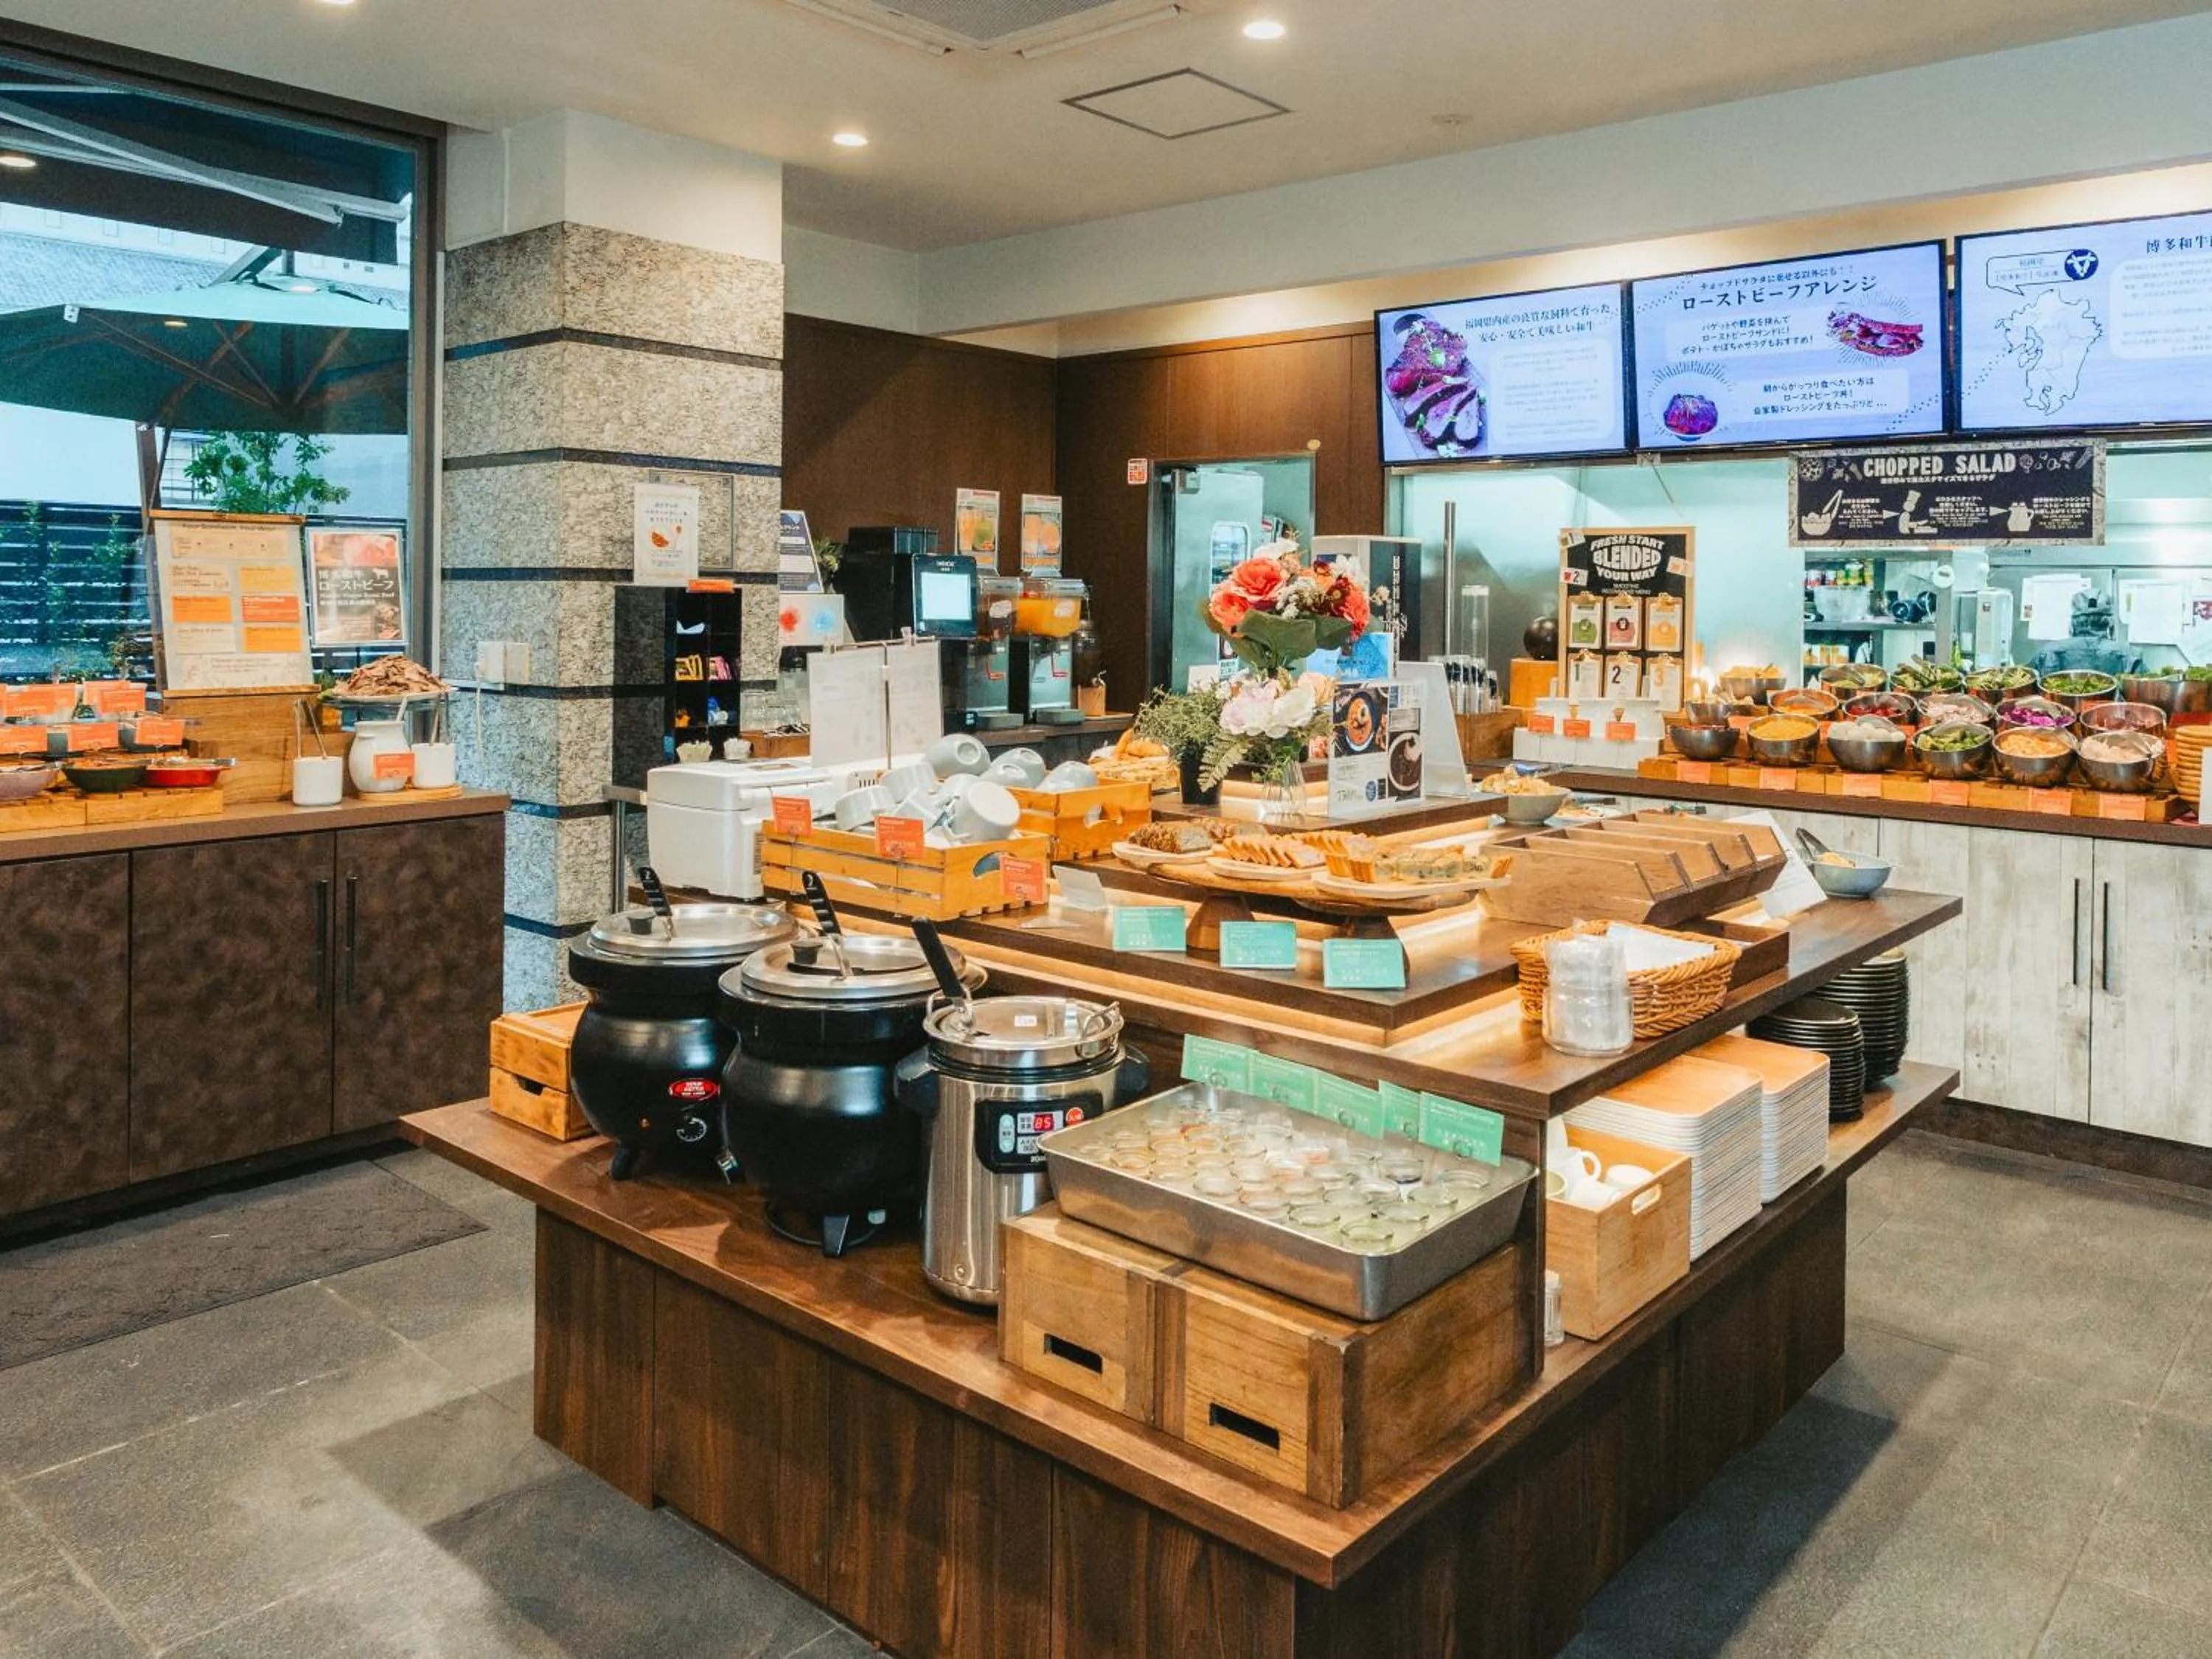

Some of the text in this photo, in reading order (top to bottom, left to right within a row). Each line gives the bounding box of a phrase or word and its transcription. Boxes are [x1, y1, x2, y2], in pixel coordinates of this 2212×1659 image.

[2146, 235, 2212, 253] 博多和牛
[1683, 274, 1877, 310] ローストビーフアレンジ
[1863, 453, 2016, 477] CHOPPED SALAD
[1590, 535, 1666, 551] FRESH START
[1592, 544, 1662, 571] BLENDED
[1596, 567, 1658, 582] YOUR WAY
[319, 579, 394, 591] ローストビーフ
[1612, 665, 1622, 684] 2
[1034, 1116, 1051, 1129] 85
